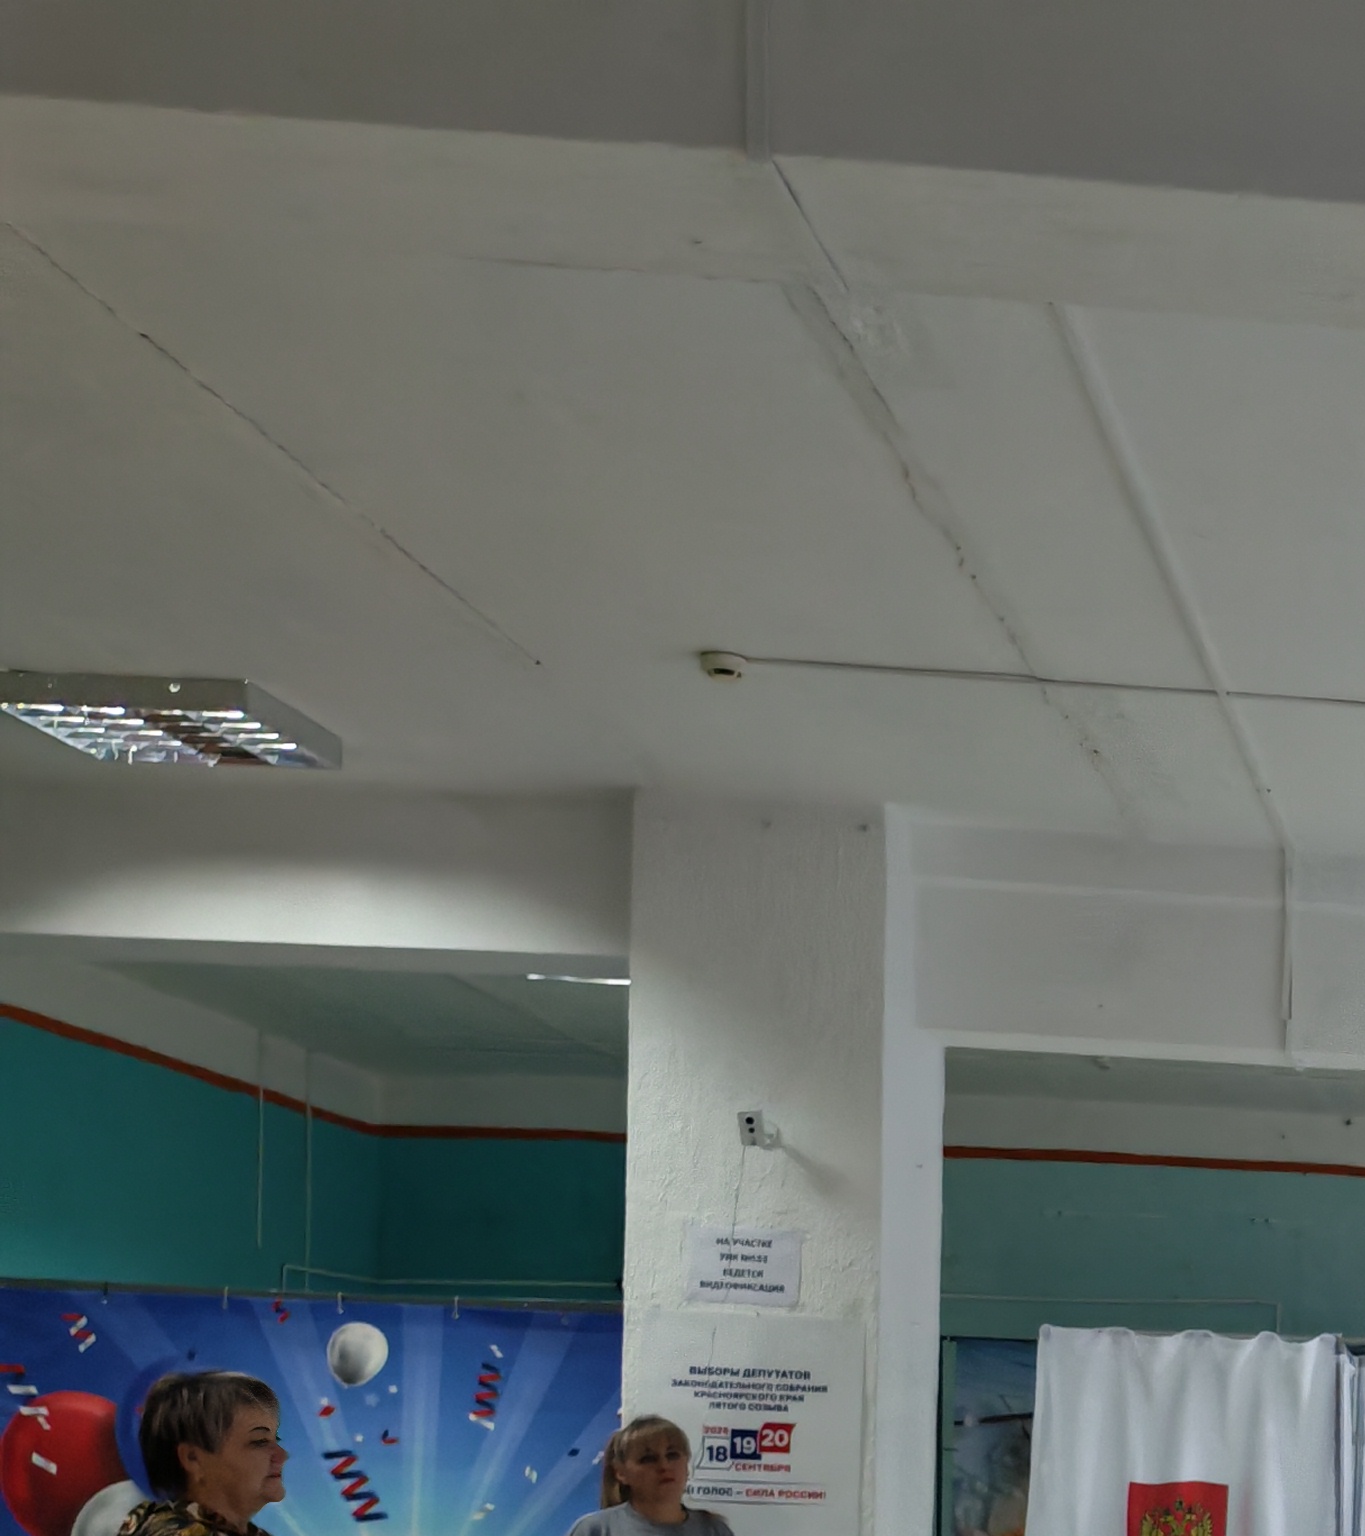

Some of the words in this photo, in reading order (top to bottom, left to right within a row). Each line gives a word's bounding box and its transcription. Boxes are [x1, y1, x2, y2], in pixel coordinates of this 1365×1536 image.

[689, 1366, 740, 1377] ВЫБОРЫ
[742, 1368, 811, 1380] ДЕПУТАТОВ
[671, 1378, 773, 1392] ЗАКОНОДАТЕЛЬНОГО
[775, 1384, 828, 1393] СОБРАНИЯ
[693, 1391, 777, 1402] КРАСНОЯРСКОГО
[779, 1394, 805, 1403] КРАЯ
[708, 1402, 746, 1411] ПЯТОГО
[748, 1403, 789, 1412] СОЗЫВА
[706, 1445, 728, 1463] 18
[733, 1436, 757, 1454] 19
[761, 1429, 789, 1448] 20
[734, 1463, 791, 1473] СЕНТЯБРЯ
[745, 1488, 775, 1498] СИЛА
